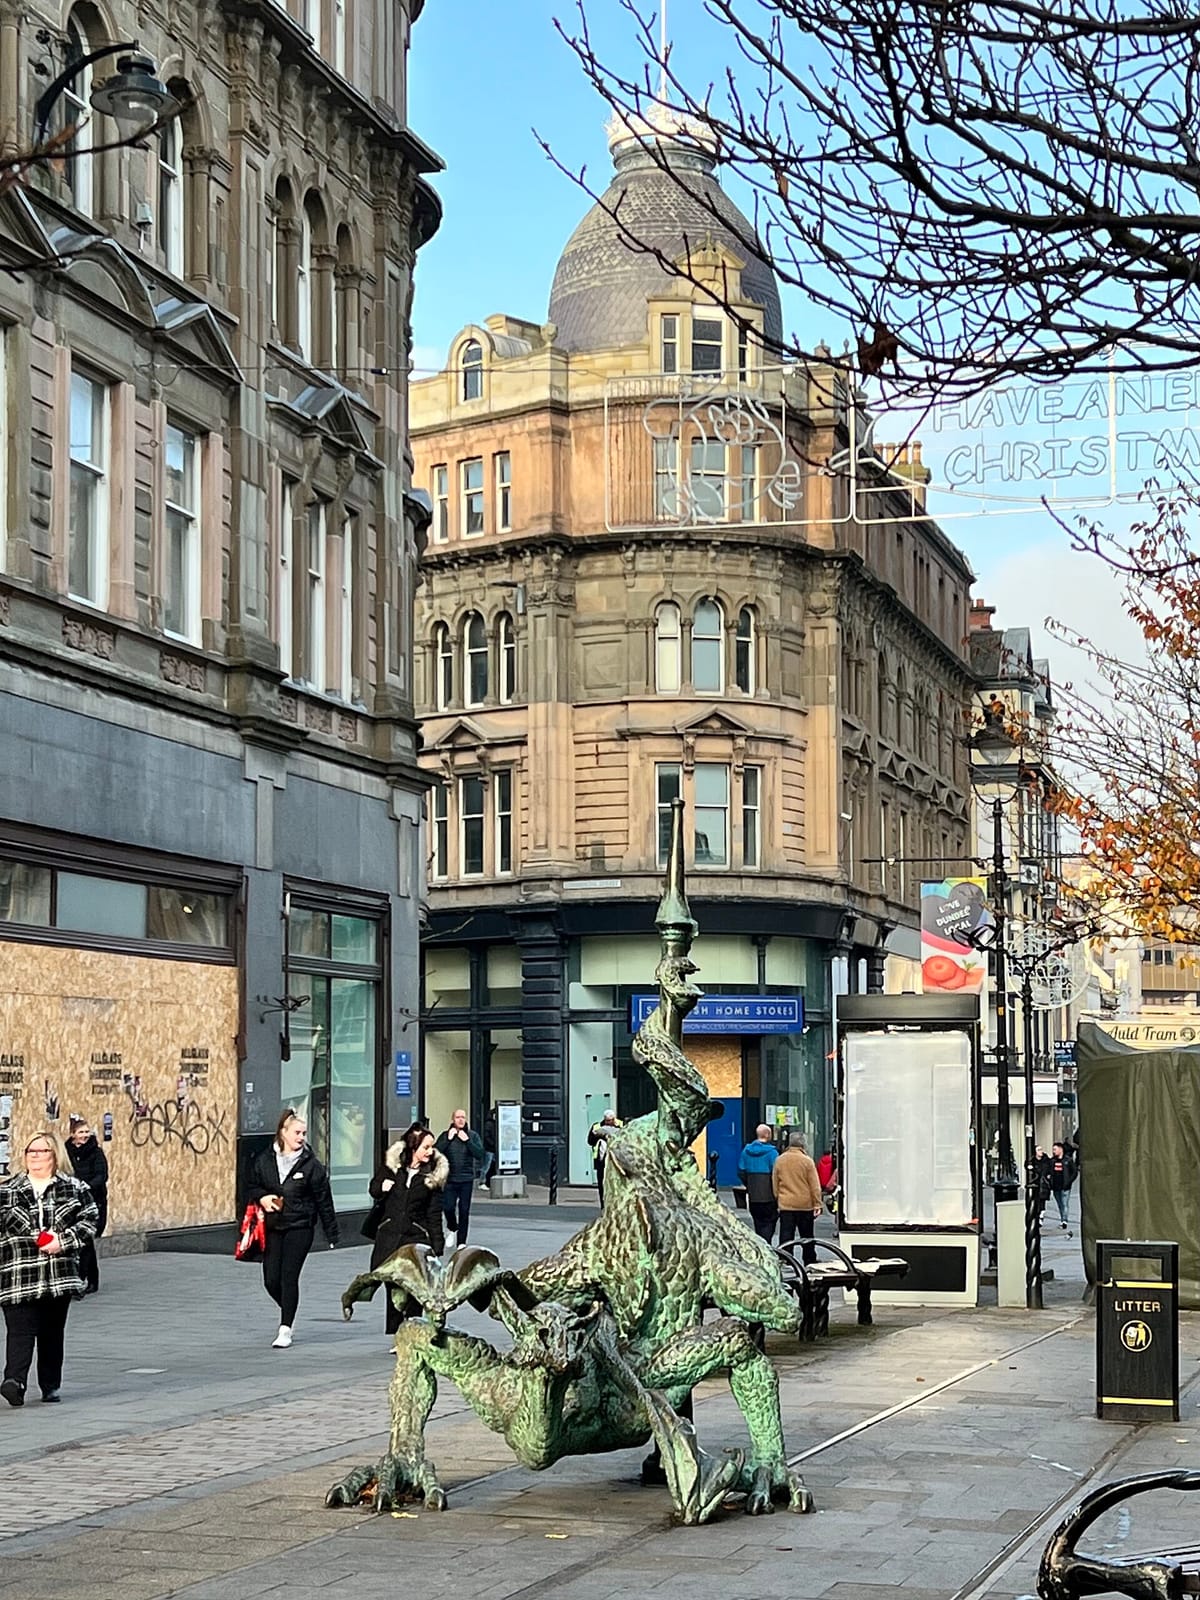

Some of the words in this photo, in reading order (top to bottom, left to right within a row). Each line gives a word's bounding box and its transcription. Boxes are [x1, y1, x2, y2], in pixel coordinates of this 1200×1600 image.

[934, 384, 1064, 432] HAVE
[935, 905, 971, 927] DUNDEE
[943, 919, 972, 936] LOCAL
[715, 1006, 750, 1016] HOME
[755, 1006, 793, 1016] STORES
[1107, 1025, 1139, 1041] Auld
[1142, 1026, 1177, 1041] Tram
[1061, 1041, 1075, 1049] LET
[1114, 1300, 1161, 1313] LITTER
